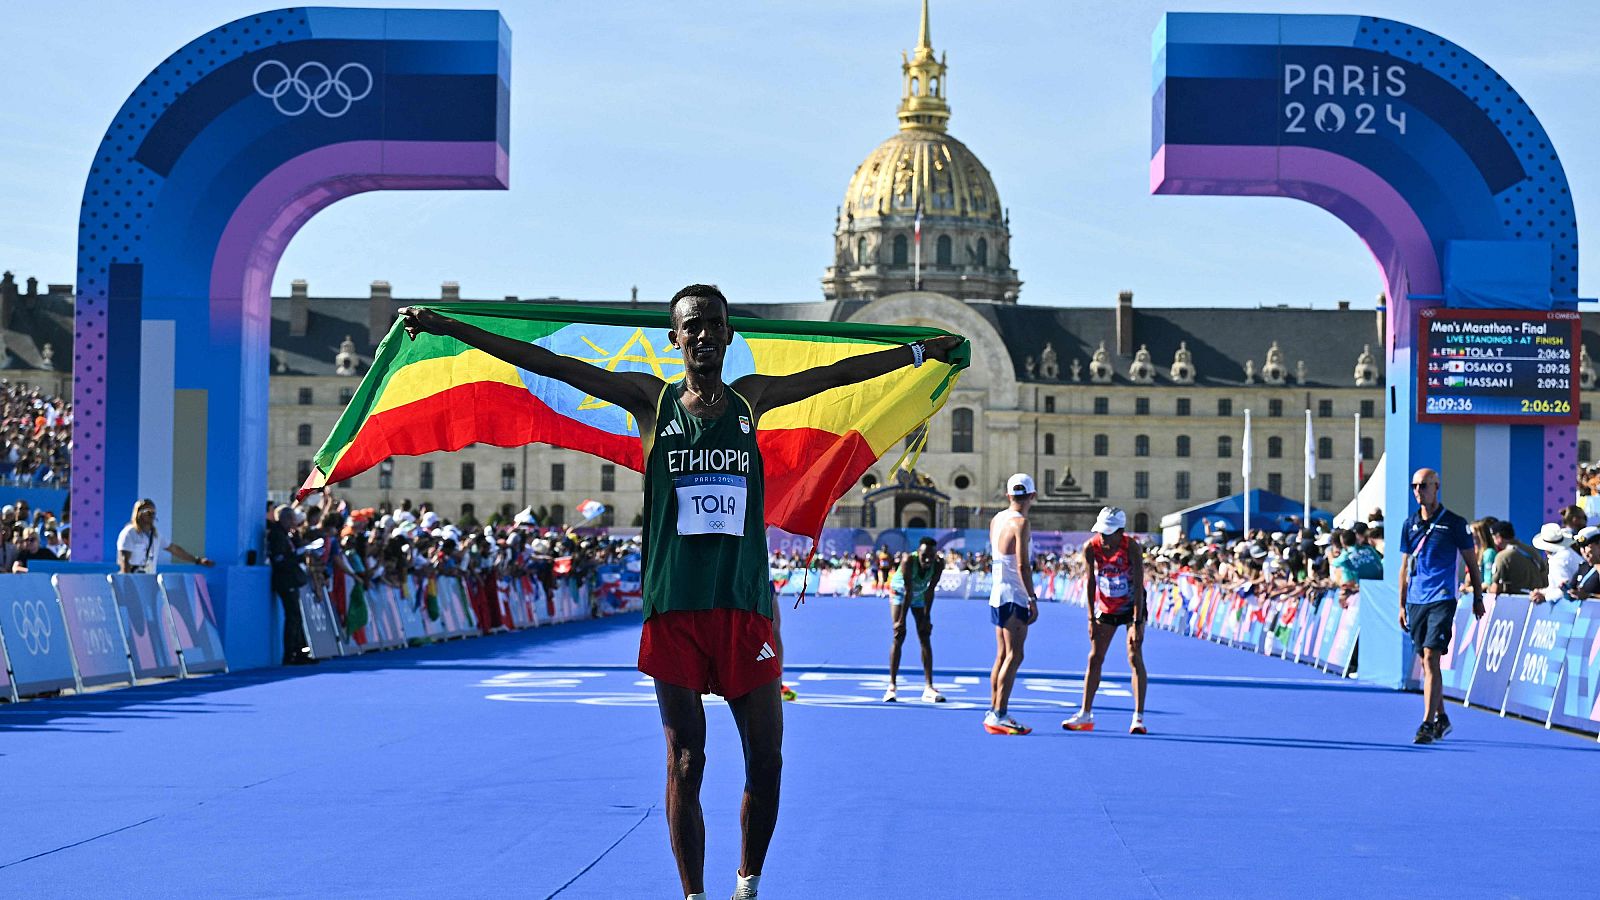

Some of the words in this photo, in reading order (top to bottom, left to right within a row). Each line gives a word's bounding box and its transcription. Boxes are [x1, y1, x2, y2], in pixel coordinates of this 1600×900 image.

[1284, 102, 1406, 135] 2024
[1554, 312, 1581, 320] OMEGA
[1430, 321, 1460, 333] Men's
[1462, 322, 1513, 334] Marathon
[1521, 322, 1547, 334] Final
[1446, 335, 1464, 344] LIVE
[1465, 335, 1513, 345] STANDINGS
[1520, 336, 1532, 345] AT
[1535, 336, 1564, 346] FINISH
[1441, 347, 1457, 356] ETH
[1464, 347, 1495, 358] TOLA
[1496, 347, 1504, 358] T
[1537, 348, 1571, 360] 2:06:26
[1464, 361, 1505, 373] OSAKO
[1505, 362, 1513, 374] S
[1537, 363, 1571, 374] 2:09:25
[1464, 377, 1508, 388] HASSAN
[1509, 378, 1514, 388] I
[1536, 377, 1570, 389] 2:09:31
[1427, 397, 1473, 411] 2:09:36
[1520, 399, 1571, 413] 2:06:26
[667, 449, 750, 474] ETHIOPIA
[718, 476, 734, 484] 2024
[691, 494, 736, 516] TOLA
[1519, 652, 1549, 685] 2024
